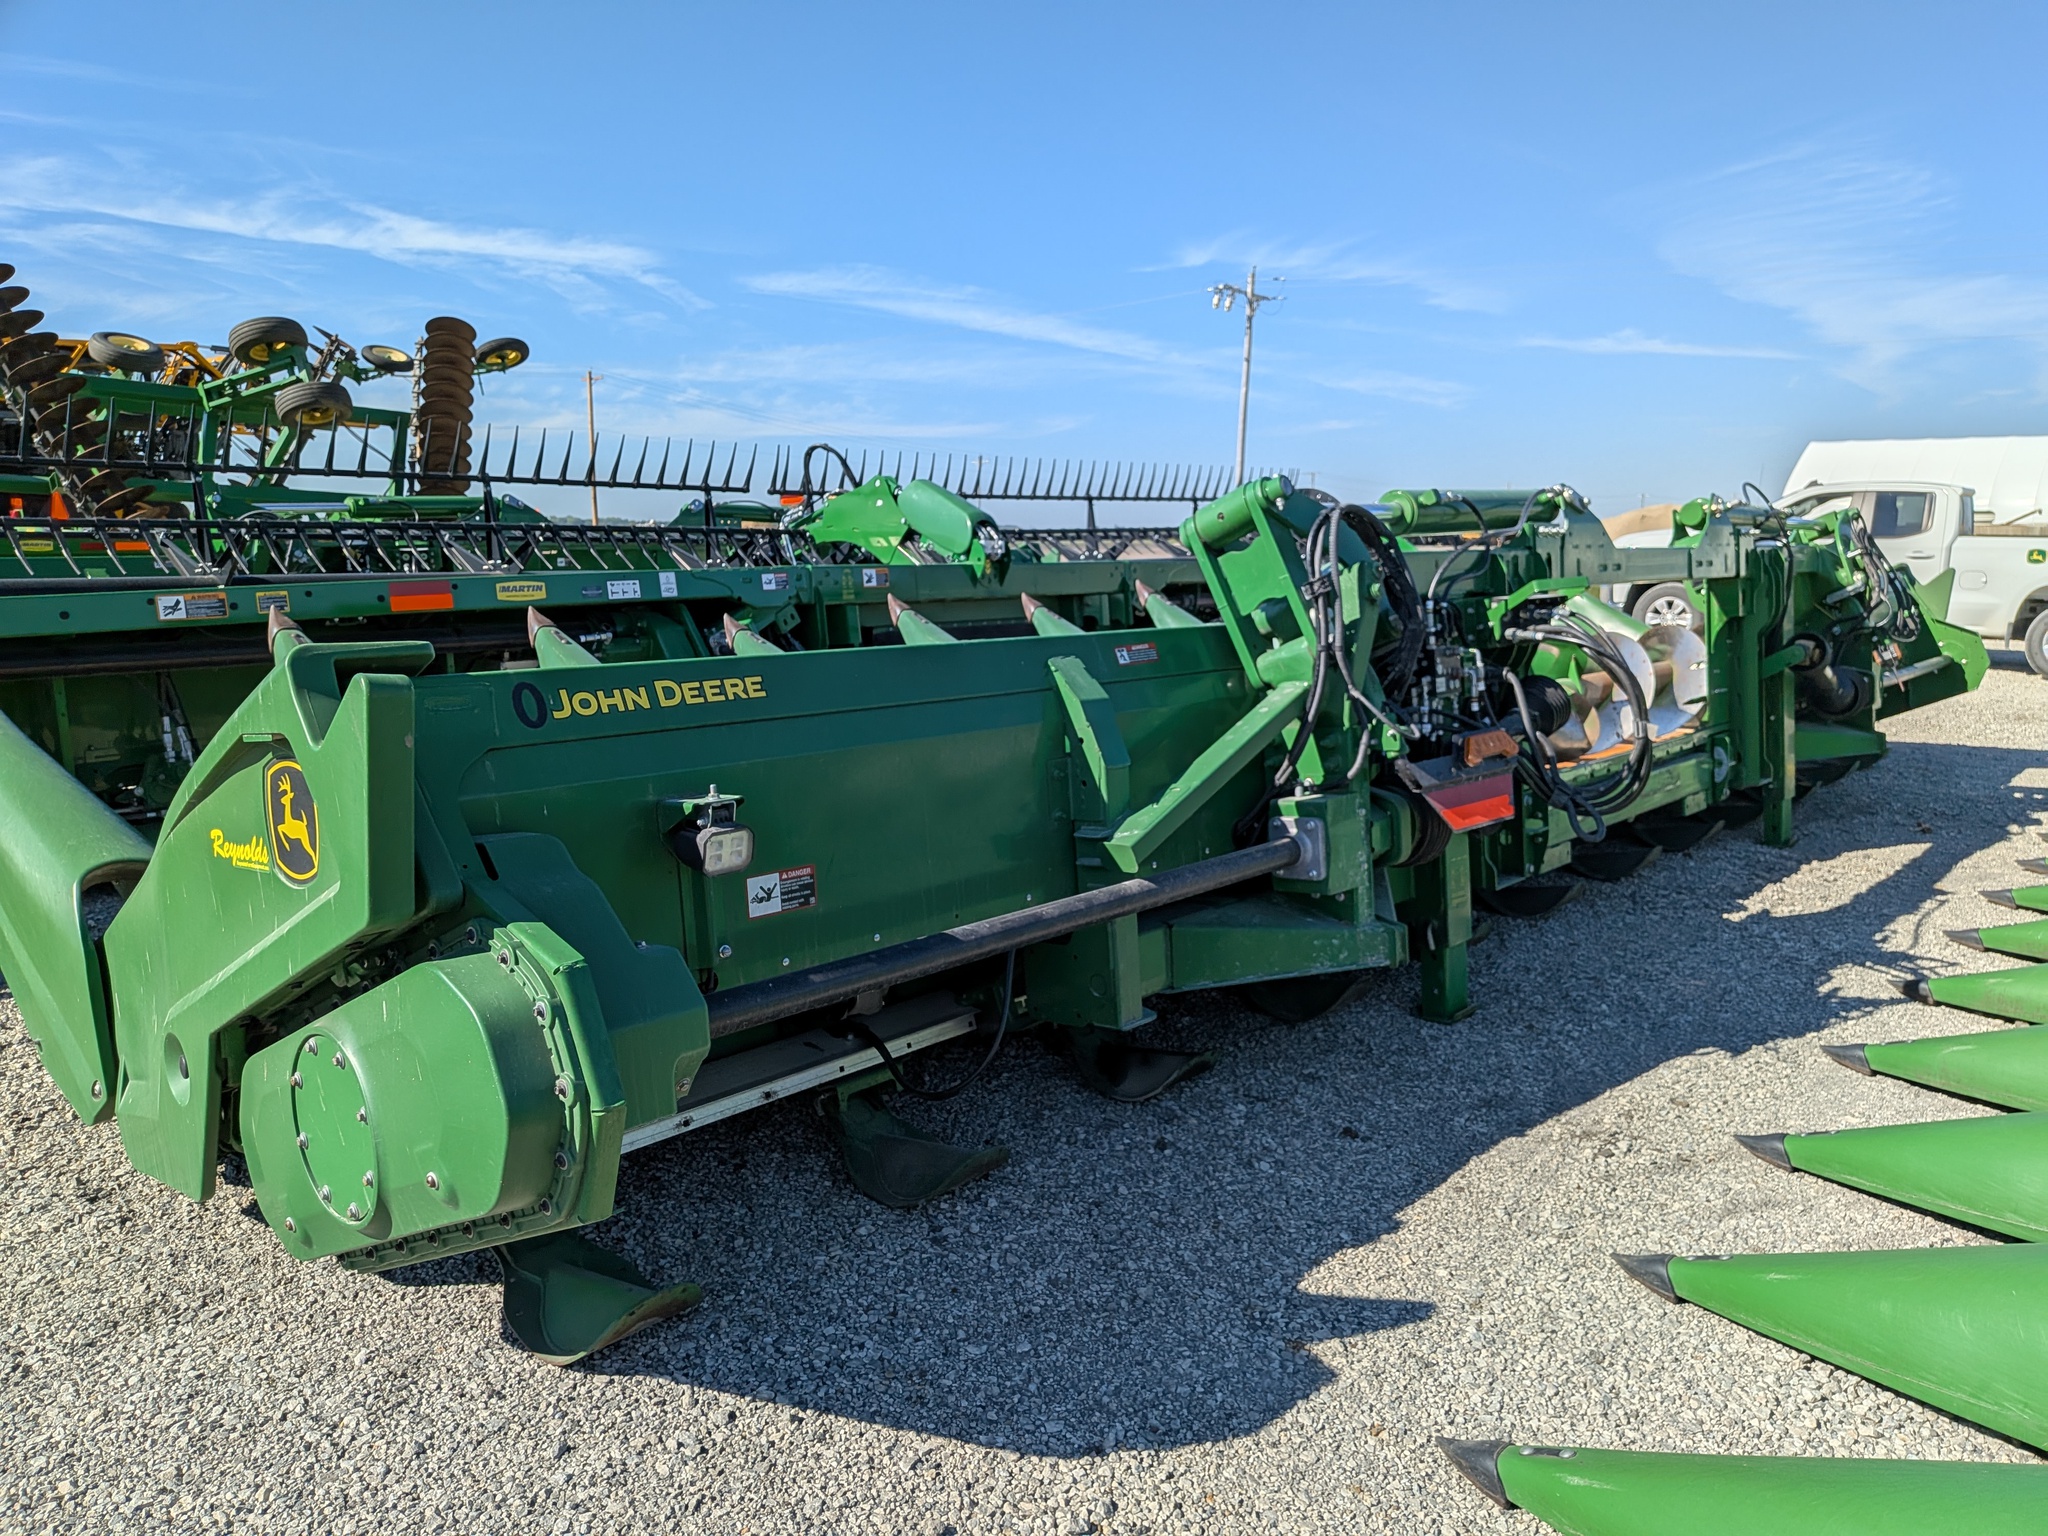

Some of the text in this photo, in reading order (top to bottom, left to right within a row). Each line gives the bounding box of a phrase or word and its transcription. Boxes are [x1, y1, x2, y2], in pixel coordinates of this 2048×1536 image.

[500, 584, 544, 593] MARTIN
[551, 675, 767, 719] JOHN DEERE
[210, 828, 269, 867] Reynolds
[787, 867, 811, 878] DANGER
